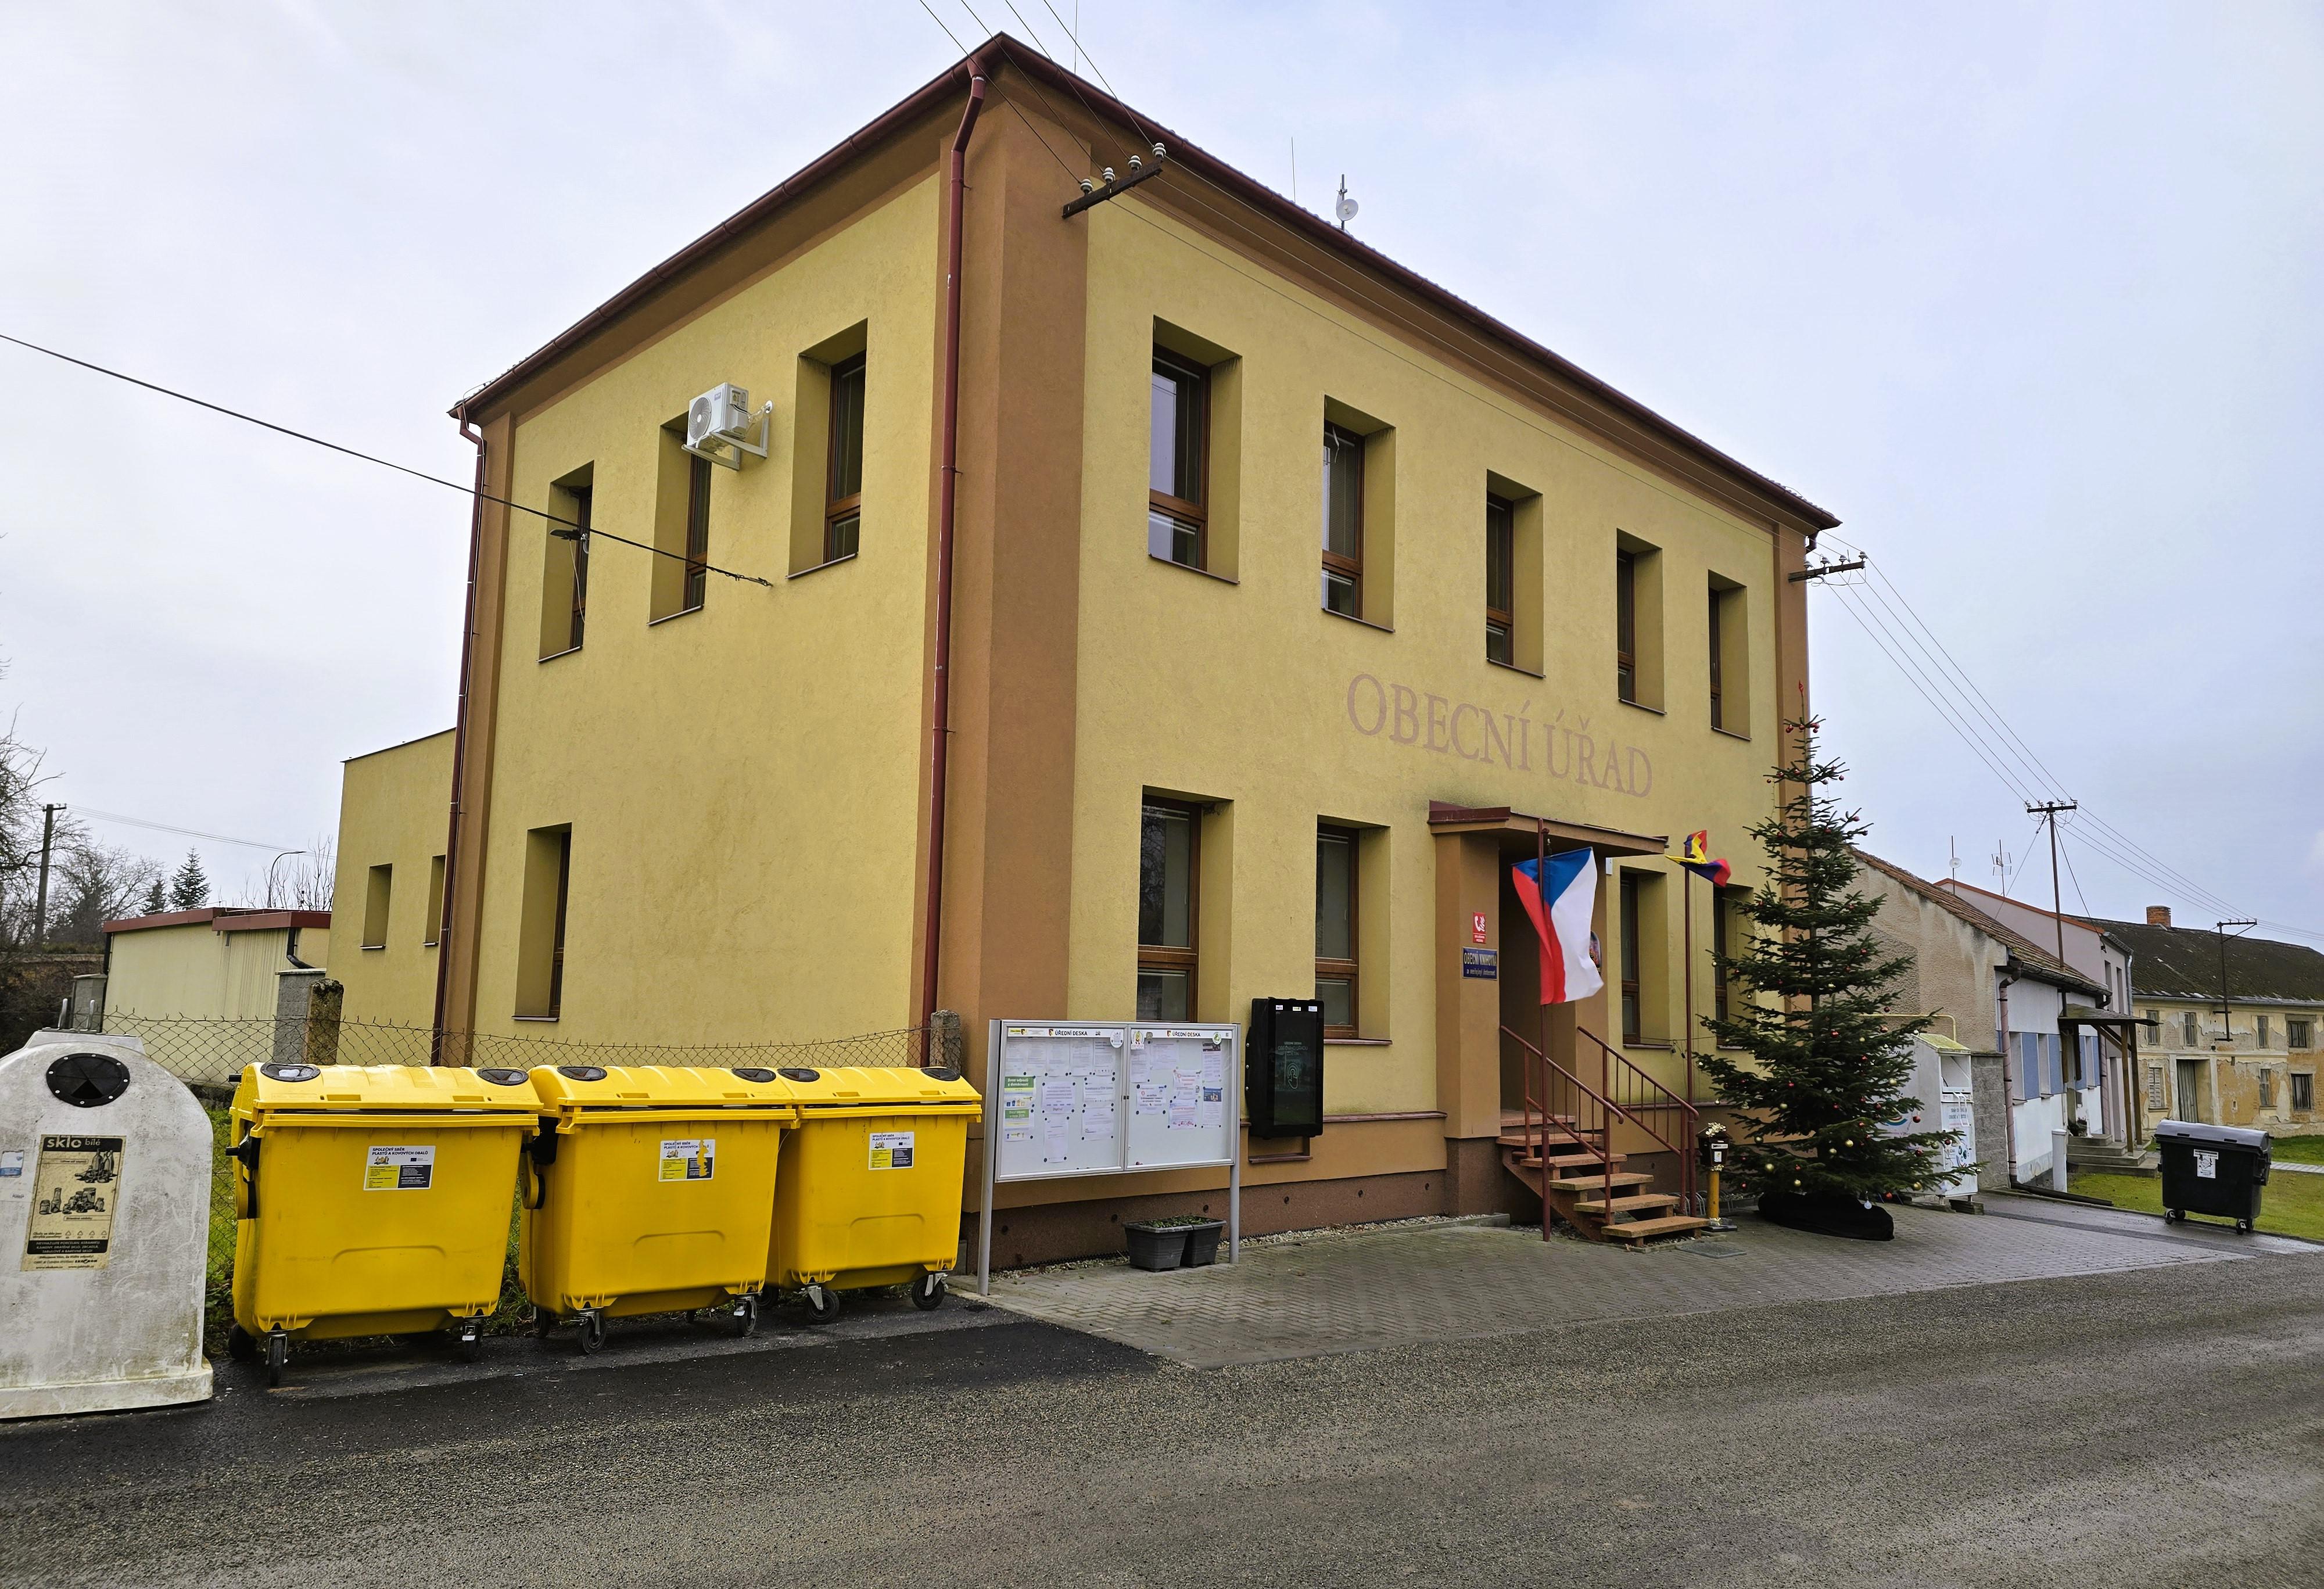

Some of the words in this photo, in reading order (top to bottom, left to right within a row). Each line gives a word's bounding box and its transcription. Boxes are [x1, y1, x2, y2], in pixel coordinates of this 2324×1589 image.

[1346, 674, 1530, 772] OBECNÍ
[1544, 709, 1652, 798] ÚŘAD
[1464, 951, 1479, 965] OBECNÍ
[46, 1134, 82, 1148] sklo
